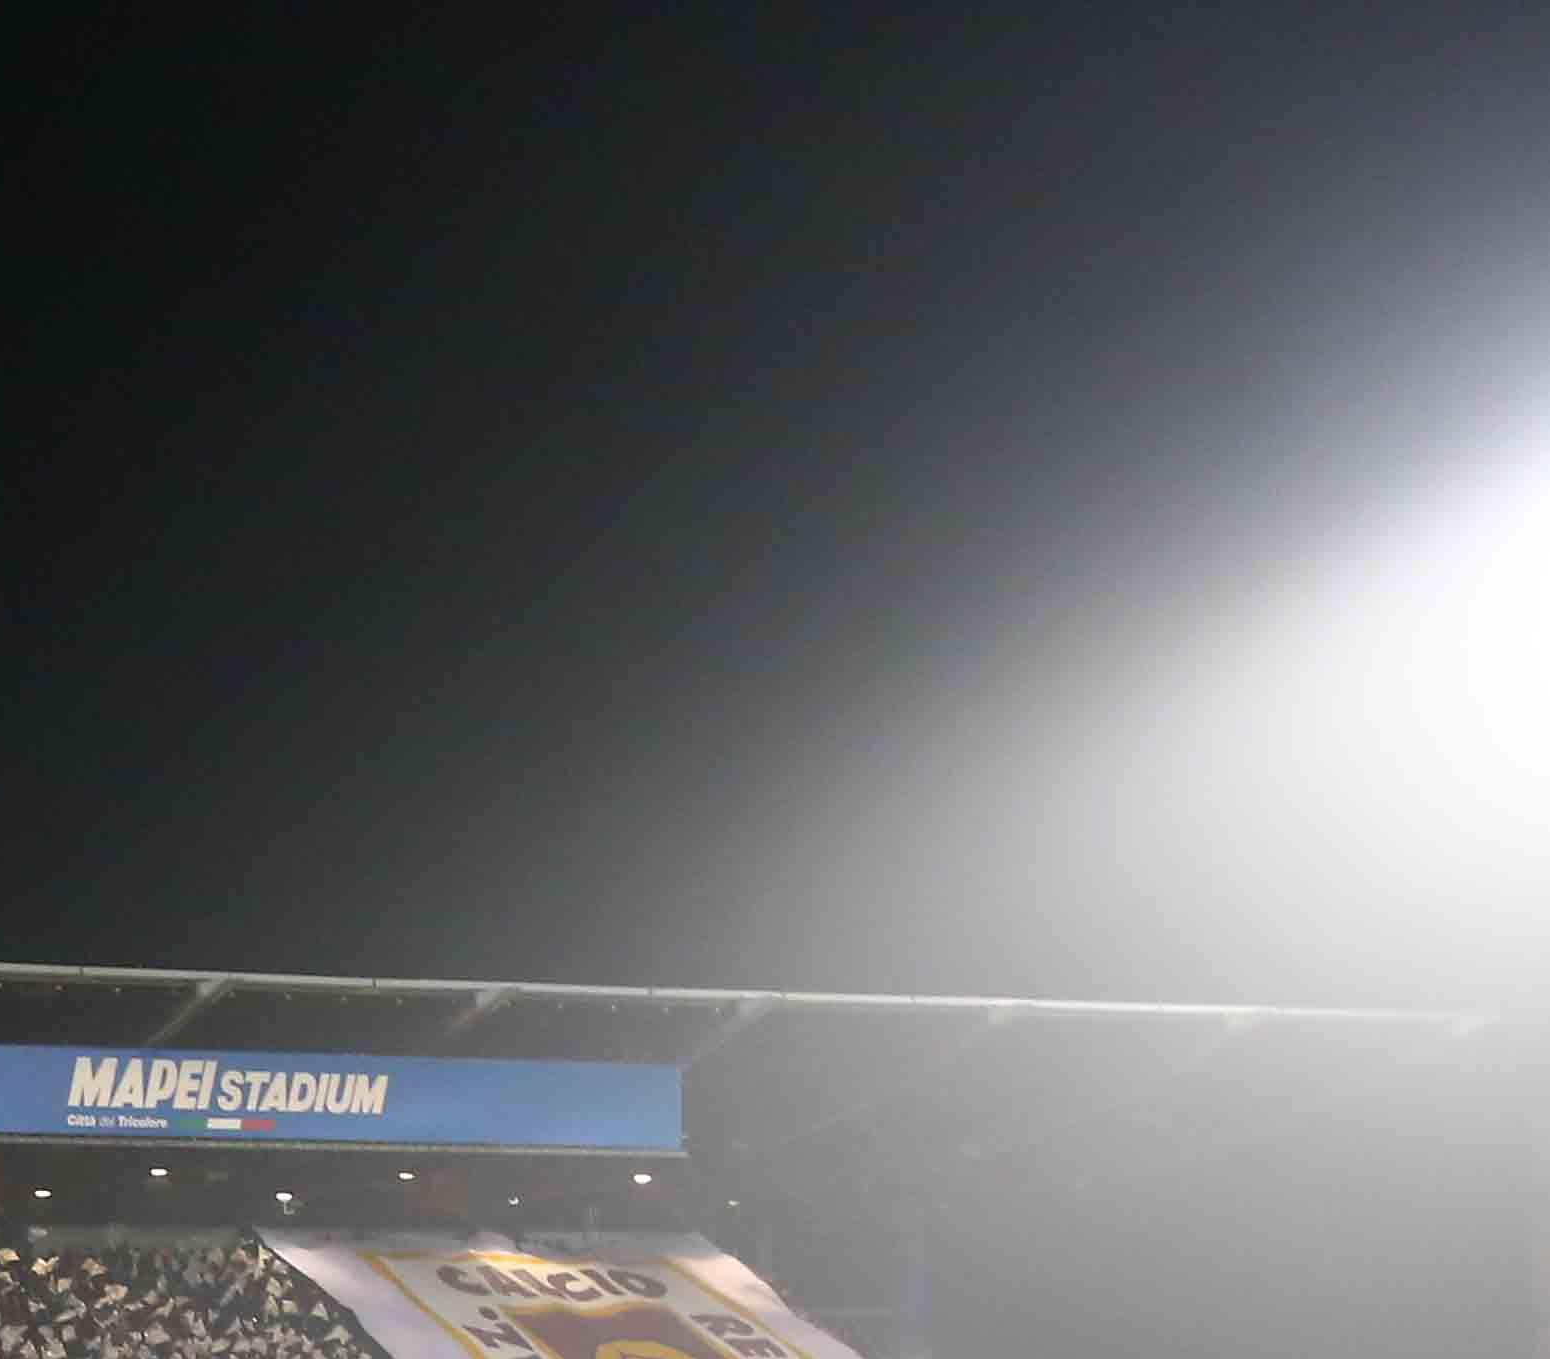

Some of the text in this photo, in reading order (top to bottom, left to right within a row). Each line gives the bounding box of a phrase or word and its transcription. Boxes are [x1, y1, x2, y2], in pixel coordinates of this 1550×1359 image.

[67, 1056, 389, 1115] MAPEI STADIUM
[436, 1264, 668, 1302] CALCIO
